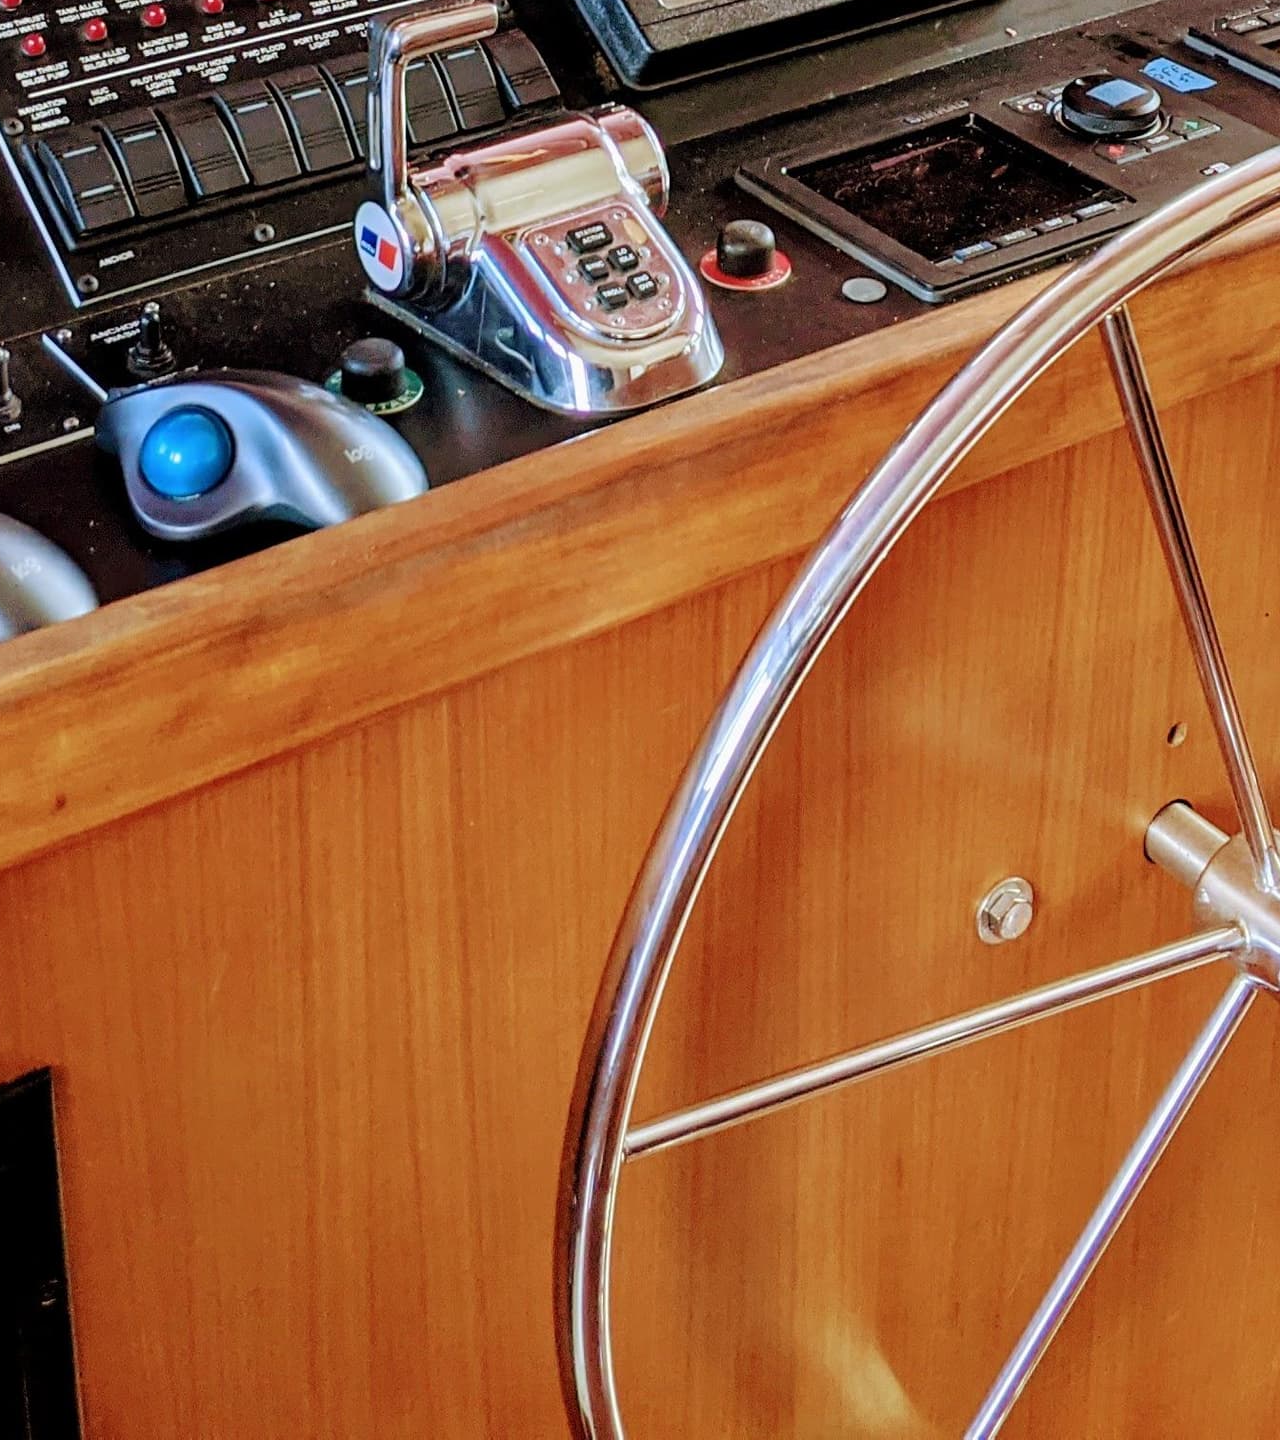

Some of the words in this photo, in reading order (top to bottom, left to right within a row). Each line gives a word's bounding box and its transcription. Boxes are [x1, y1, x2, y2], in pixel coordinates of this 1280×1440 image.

[56, 6, 77, 17] TANK
[78, 0, 104, 12] ALLEY
[60, 12, 81, 24] HIGH
[82, 7, 108, 19] WATER
[269, 9, 284, 19] LAZ
[312, 5, 331, 15] HEAT
[332, 0, 358, 11] ALARM
[13, 14, 45, 28] THRUST
[20, 22, 48, 34] WATER
[257, 19, 278, 30] BILGE
[278, 13, 302, 25] PUMP
[137, 35, 174, 50] LAUNDRY
[202, 32, 222, 43] BILGE
[222, 26, 247, 38] PUMP
[293, 35, 313, 47] PORT
[313, 30, 339, 42] FLOOD
[143, 45, 165, 57] BILGE
[166, 40, 190, 51] PUMP
[242, 48, 261, 60] FWD
[261, 43, 287, 55] FLOOD
[309, 39, 330, 51] LIGHT
[79, 52, 101, 64] TANK
[102, 47, 127, 58] ALLEY
[83, 59, 106, 72] BILGE
[106, 54, 131, 66] PUMP
[256, 51, 279, 64] LIGHT
[15, 68, 36, 81] BOW
[37, 61, 68, 75] THRUST
[186, 61, 208, 73] PILOT
[209, 55, 237, 66] HOUSE
[201, 65, 229, 78] LIGHTS
[21, 76, 45, 88] BILGE
[46, 69, 70, 82] PUMP
[130, 75, 152, 87] PILOT
[153, 68, 182, 80] HOUSE
[145, 79, 175, 92] LIGHTS
[209, 73, 227, 83] RED
[88, 92, 119, 106] LIGHTS
[90, 87, 110, 97] NUC
[150, 86, 177, 98] WHITE
[18, 98, 67, 117] NAVIGATION
[31, 107, 61, 121] LIGHTS
[31, 116, 70, 132] RUNNING
